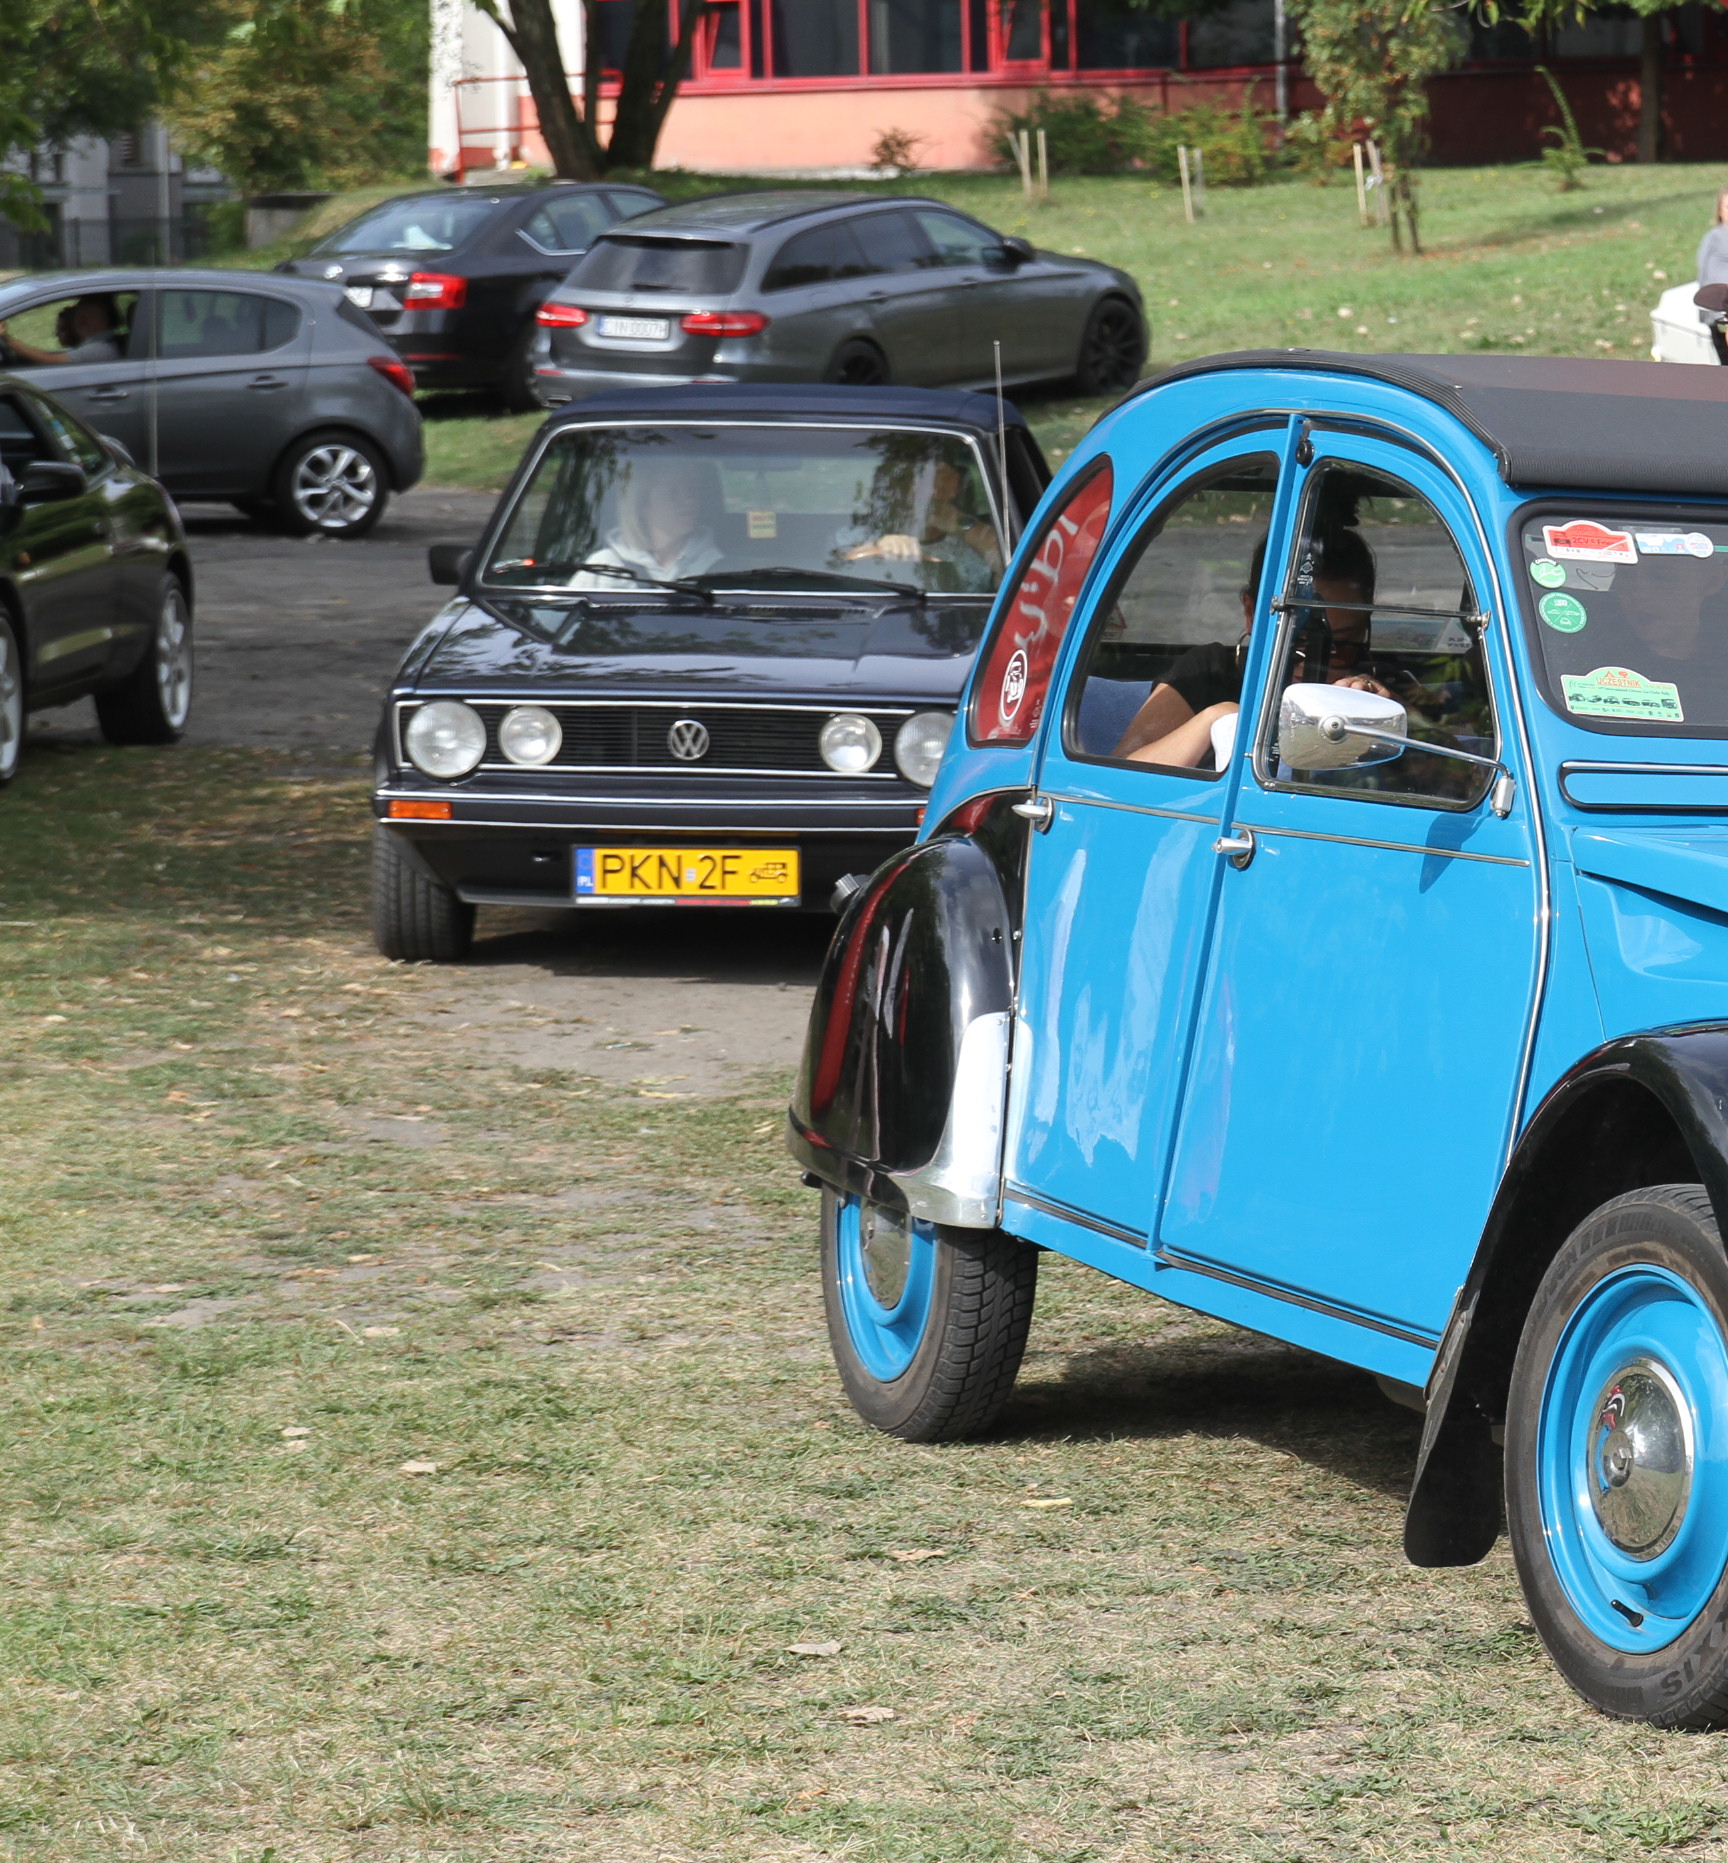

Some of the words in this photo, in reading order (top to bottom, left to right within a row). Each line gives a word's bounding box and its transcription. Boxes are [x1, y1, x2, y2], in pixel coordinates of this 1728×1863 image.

[1596, 677, 1641, 688] UCZESTNIK
[602, 854, 682, 890] PKN
[698, 855, 742, 890] 2F
